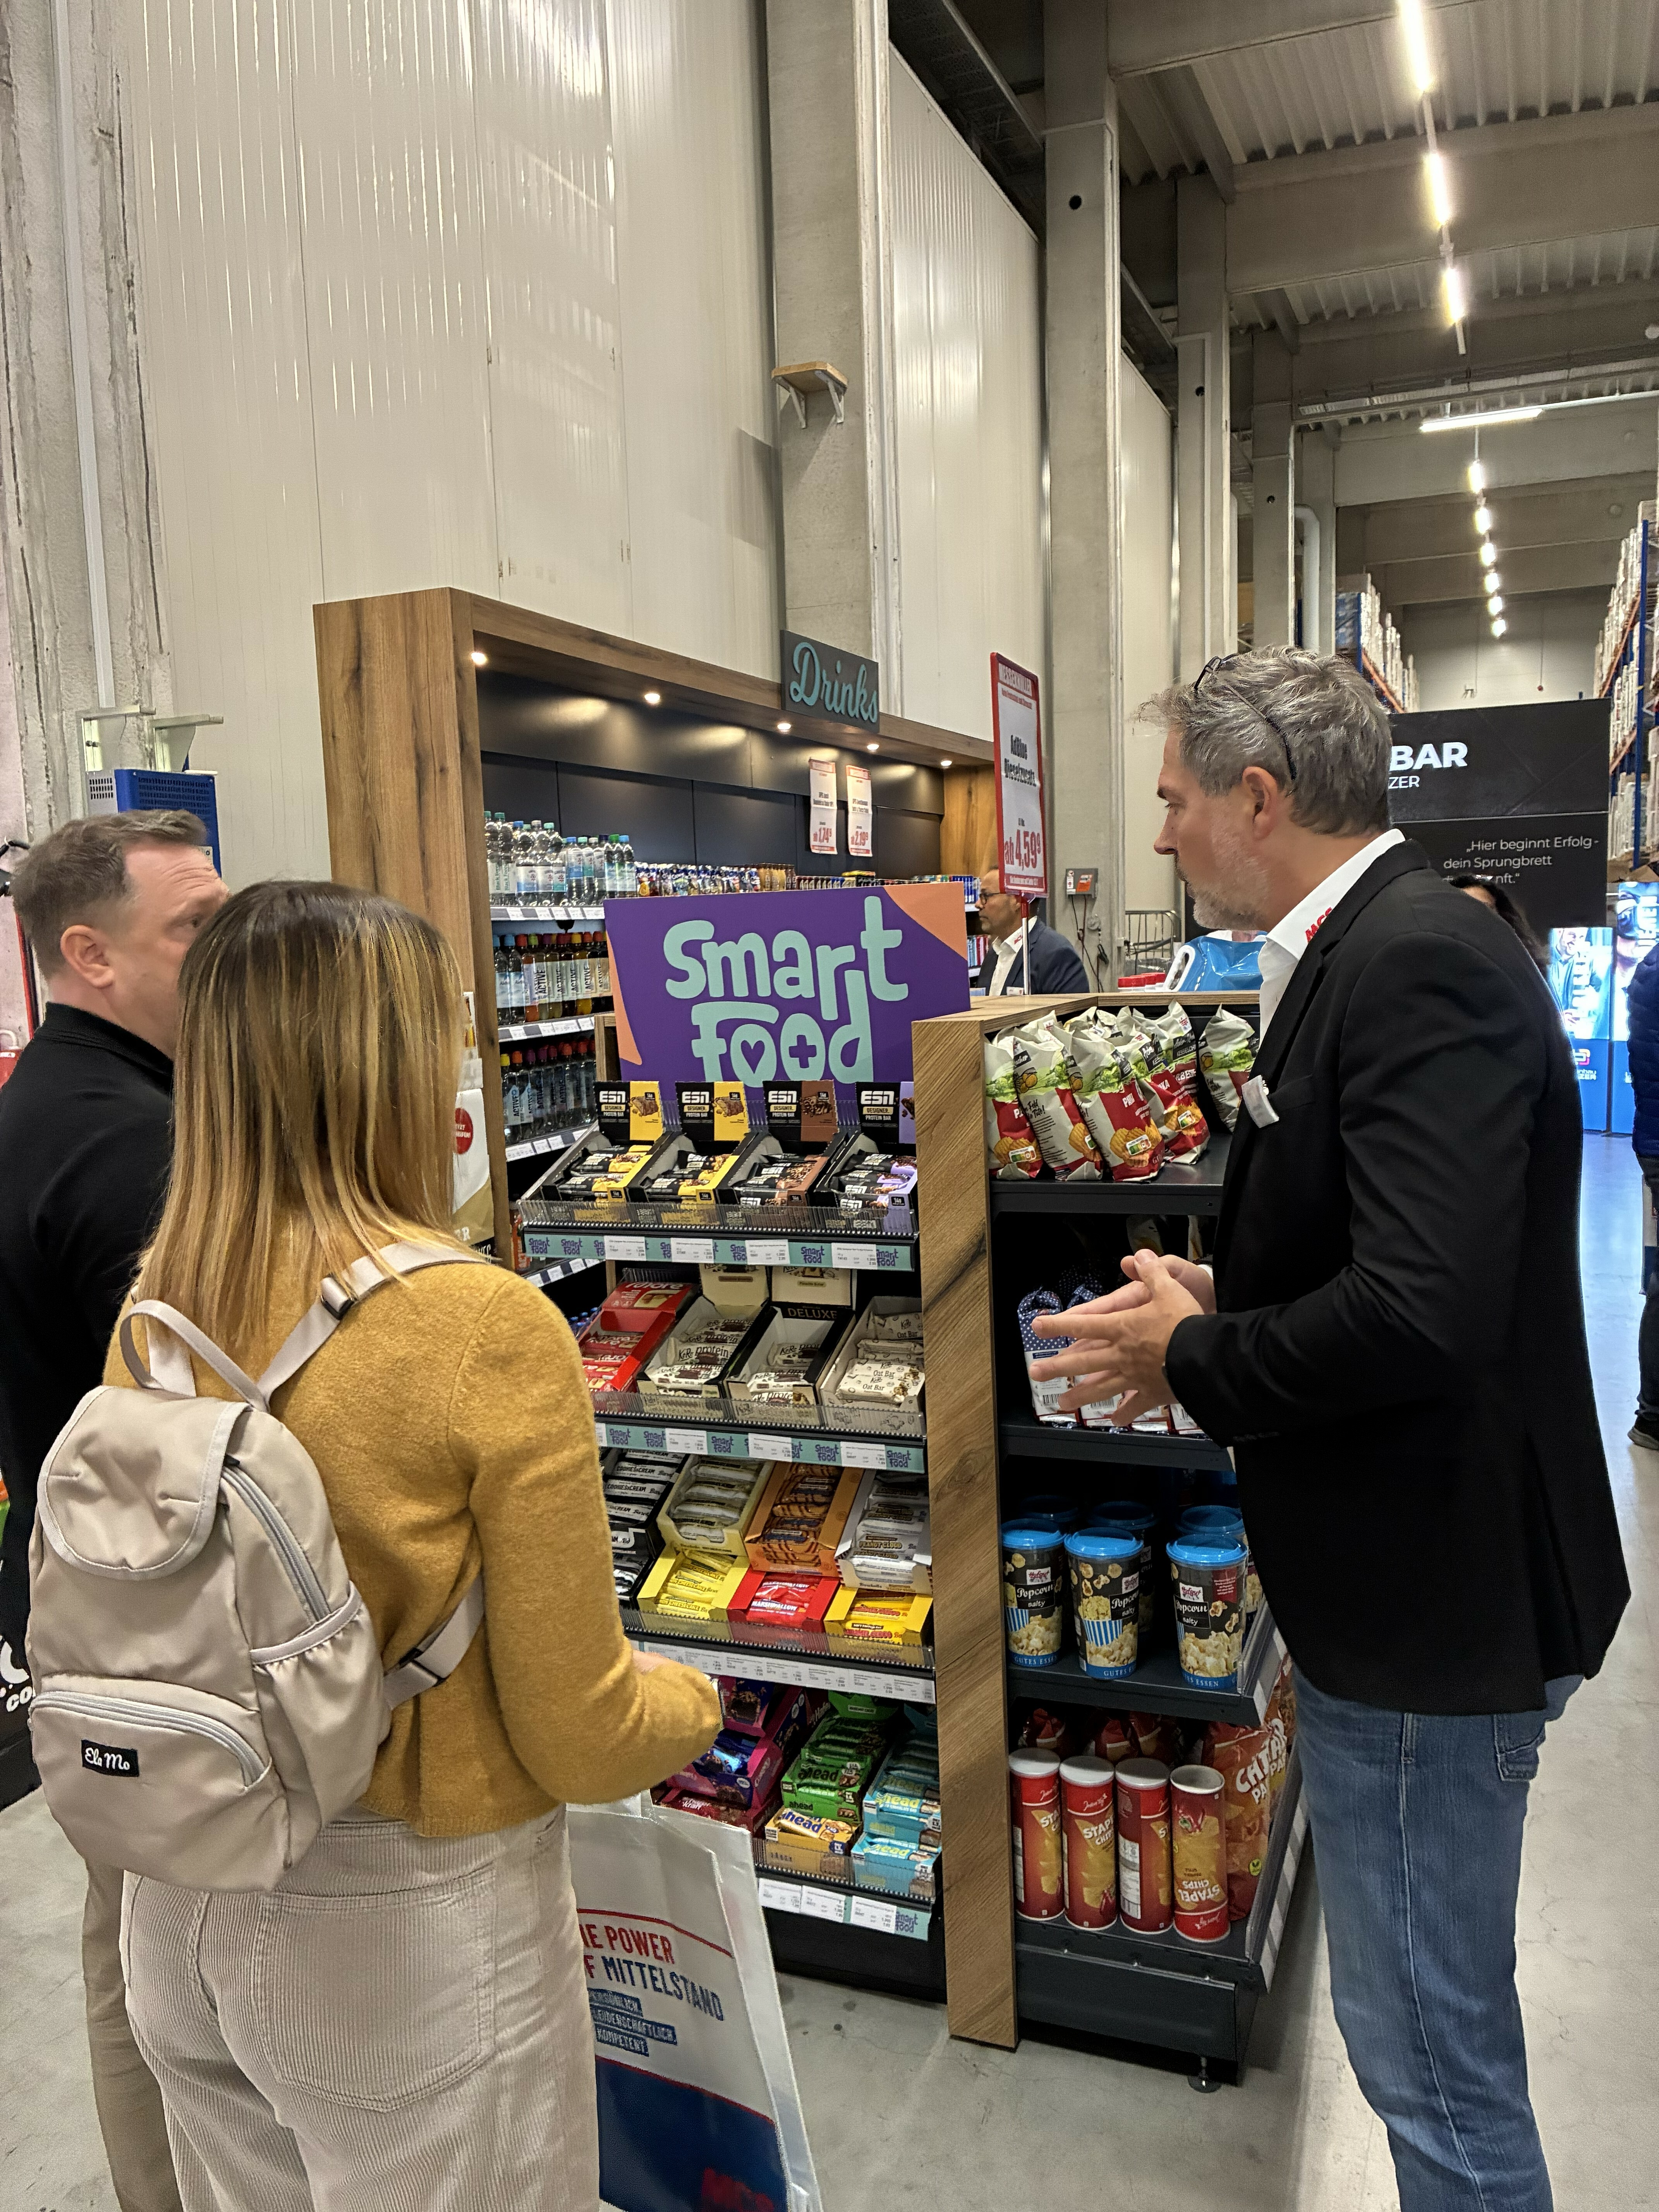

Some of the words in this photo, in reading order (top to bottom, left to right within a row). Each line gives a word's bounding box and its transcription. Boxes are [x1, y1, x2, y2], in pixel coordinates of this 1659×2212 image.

[789, 641, 878, 723] Drinks
[1388, 776, 1420, 789] ZER
[1500, 838, 1551, 852] beginnt
[1443, 857, 1471, 869] dein
[1474, 856, 1552, 870] Sprungbrett
[663, 895, 908, 1020] Smart
[537, 969, 546, 994] ACTIVE
[691, 969, 874, 1087] Food
[599, 1091, 626, 1103] ESN
[682, 1091, 709, 1103] ESN
[768, 1091, 797, 1103] ESN
[861, 1091, 894, 1104] ESN
[788, 1308, 837, 1319] DELUXE
[695, 1346, 729, 1358] protein
[1017, 1584, 1053, 1599] Popcorn
[1176, 1600, 1208, 1614] Popcorn
[1182, 1617, 1198, 1626] salty
[1039, 1655, 1058, 1664] ESSE
[1195, 1678, 1219, 1687] ESSEN
[105, 1753, 131, 1771] Mo
[1182, 1879, 1210, 1889] CHIPS
[1178, 1883, 1220, 1903] STAPEL
[604, 1925, 675, 1964] POWER
[601, 1956, 724, 2021] MITTELSTAND
